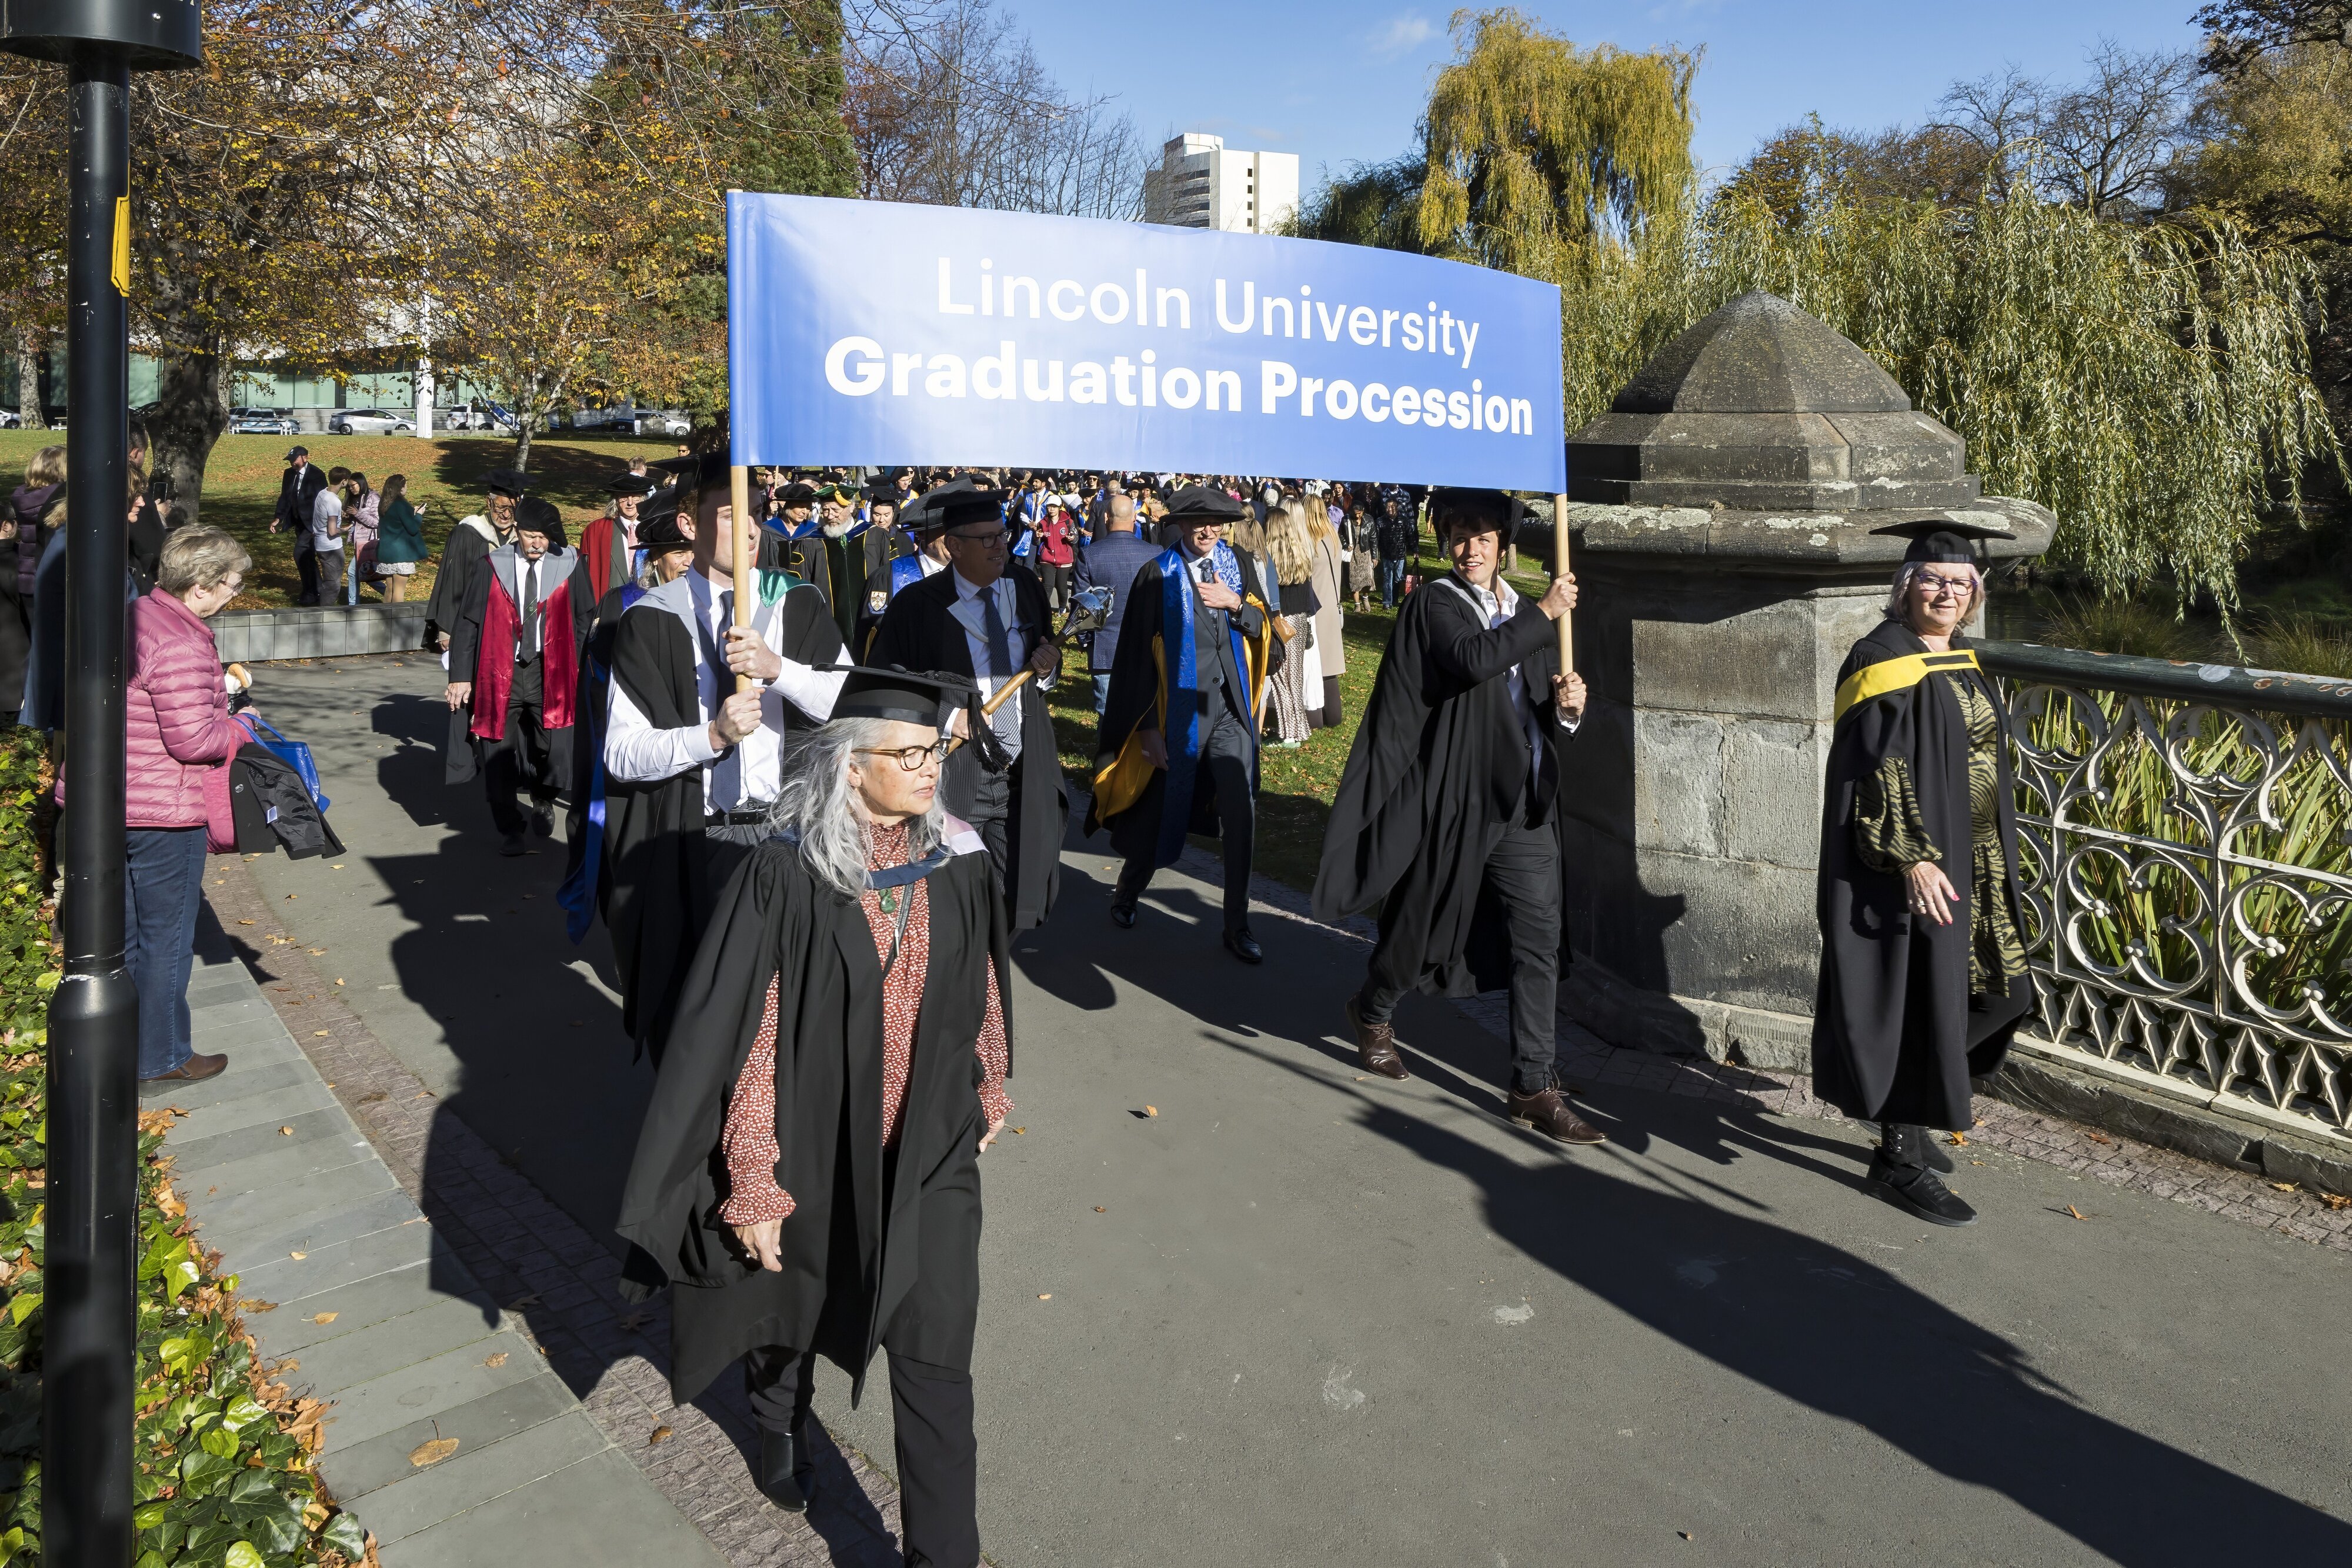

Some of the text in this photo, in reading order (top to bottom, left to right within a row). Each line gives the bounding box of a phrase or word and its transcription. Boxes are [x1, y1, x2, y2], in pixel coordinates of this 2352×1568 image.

[938, 256, 1480, 369] Lincoln University
[825, 336, 1532, 435] Graduation Procession
